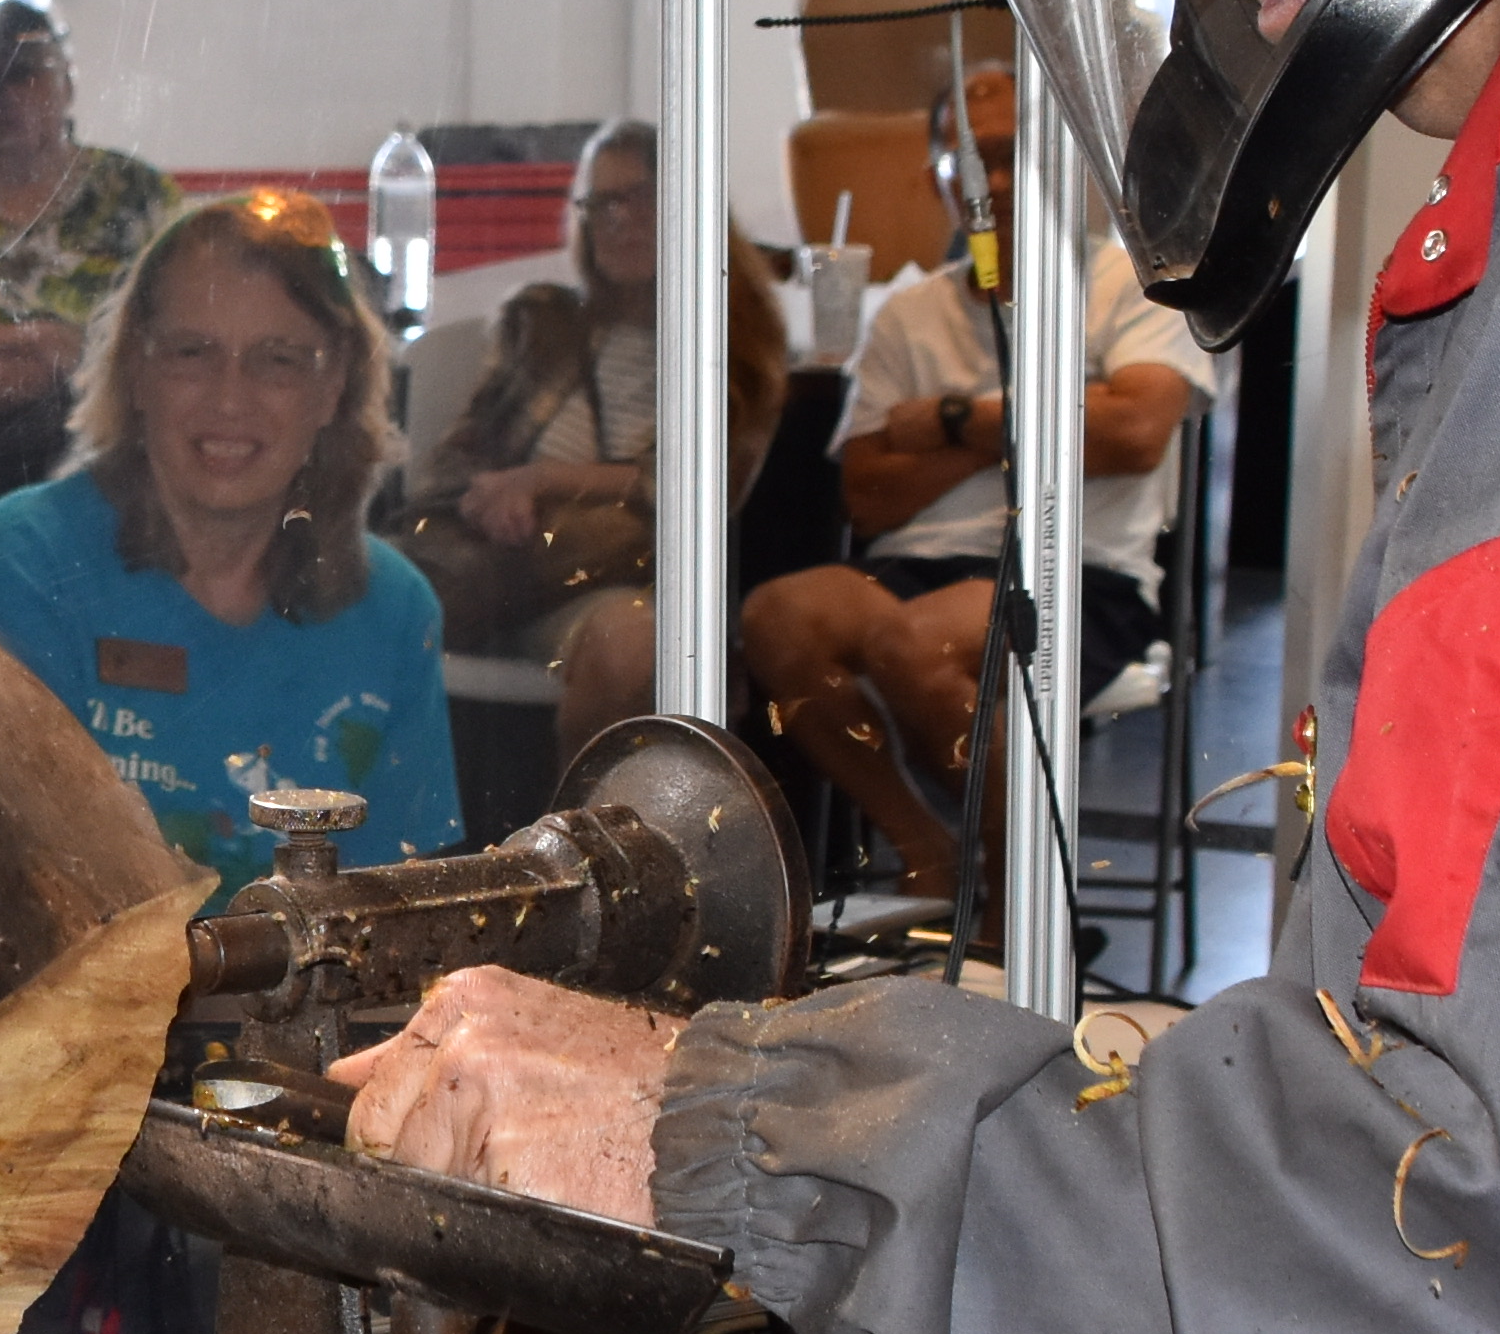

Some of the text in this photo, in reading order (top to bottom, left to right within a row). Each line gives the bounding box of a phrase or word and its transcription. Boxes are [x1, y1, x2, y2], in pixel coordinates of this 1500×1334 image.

[1040, 491, 1056, 692] UPRIGHT RIGHT FRONT
[112, 708, 155, 740] Be
